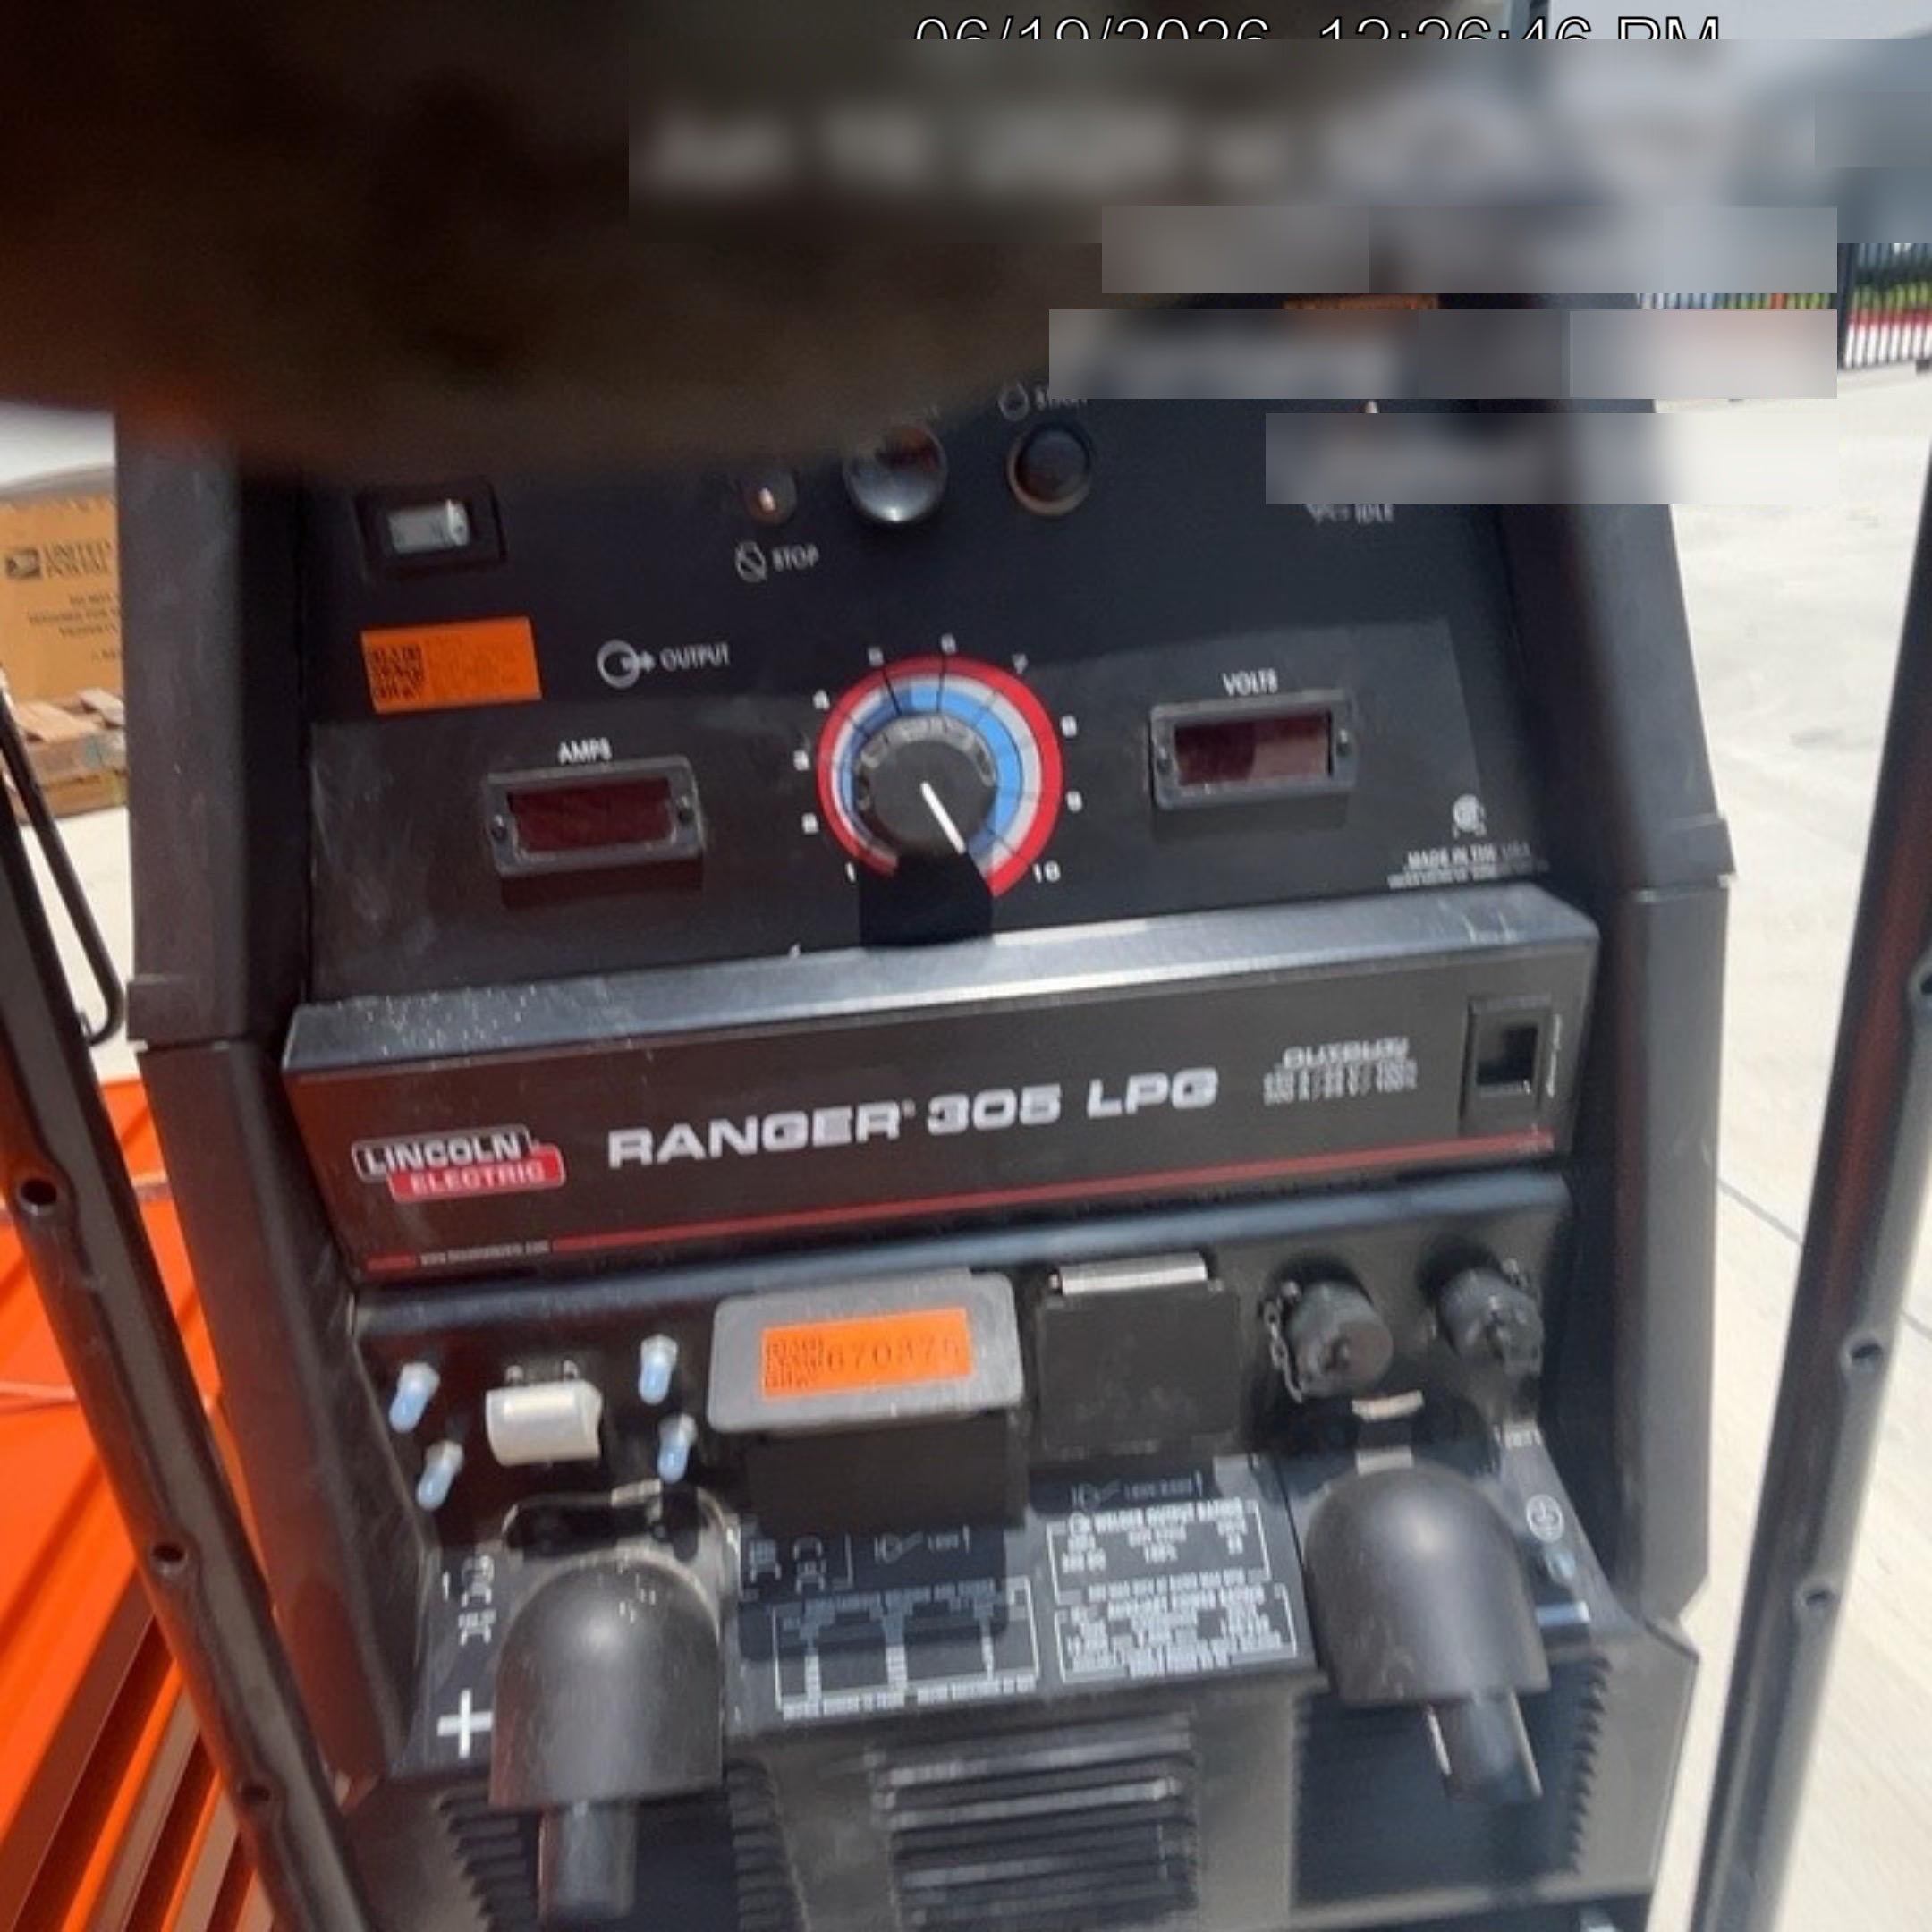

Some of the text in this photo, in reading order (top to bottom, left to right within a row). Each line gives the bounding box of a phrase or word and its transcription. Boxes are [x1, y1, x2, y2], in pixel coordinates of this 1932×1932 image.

[772, 544, 819, 572] STOP
[659, 641, 729, 671] OUTPUT
[1222, 668, 1279, 697] VOLTS
[558, 737, 612, 764] AMPS
[927, 1082, 1063, 1136] 305
[1086, 1066, 1220, 1119] LPG
[364, 1130, 522, 1175] LINCOLN
[409, 1160, 547, 1196] ELECTRIC
